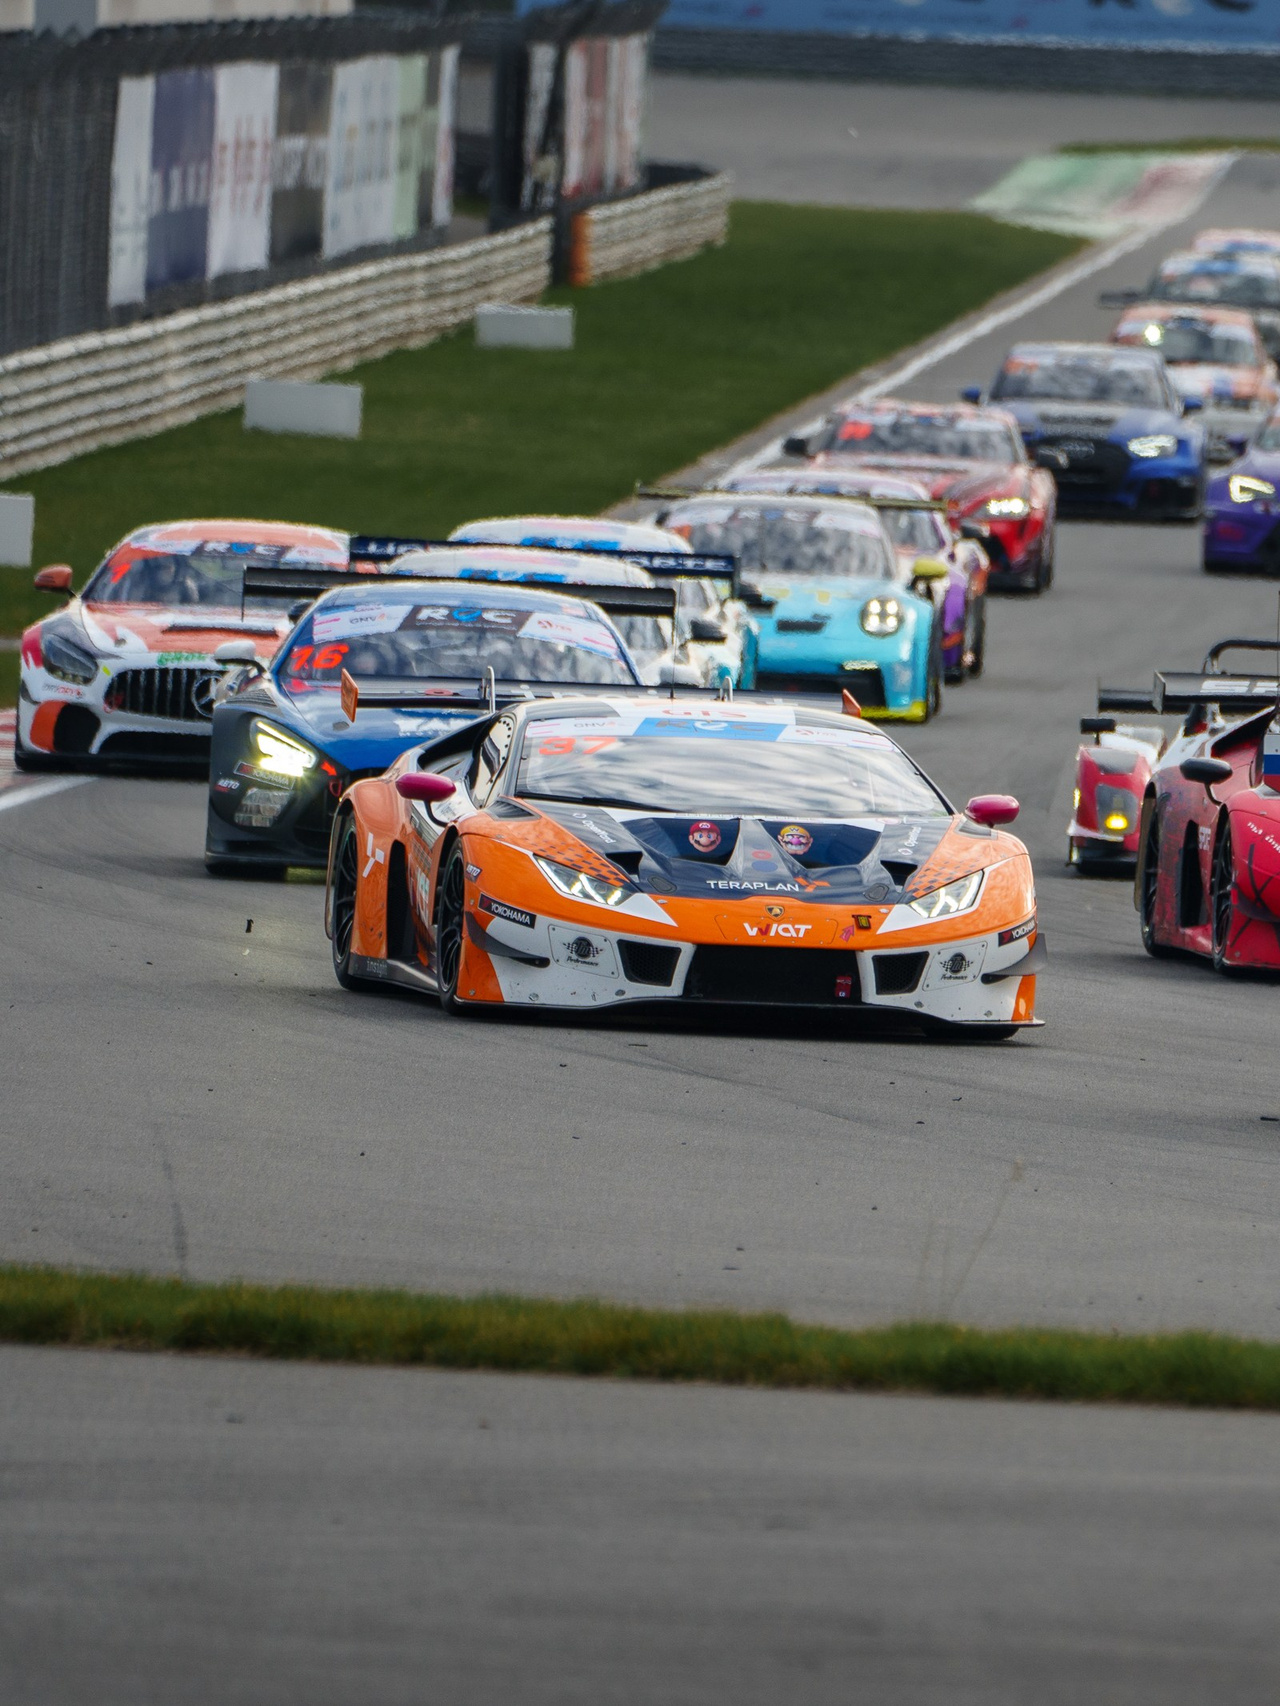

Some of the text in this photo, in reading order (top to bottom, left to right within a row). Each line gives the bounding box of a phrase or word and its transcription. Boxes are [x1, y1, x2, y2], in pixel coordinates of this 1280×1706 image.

[290, 644, 349, 671] 16
[538, 736, 618, 756] 37
[706, 880, 800, 892] TERAPLAN
[490, 902, 531, 925] YOKOHAMA
